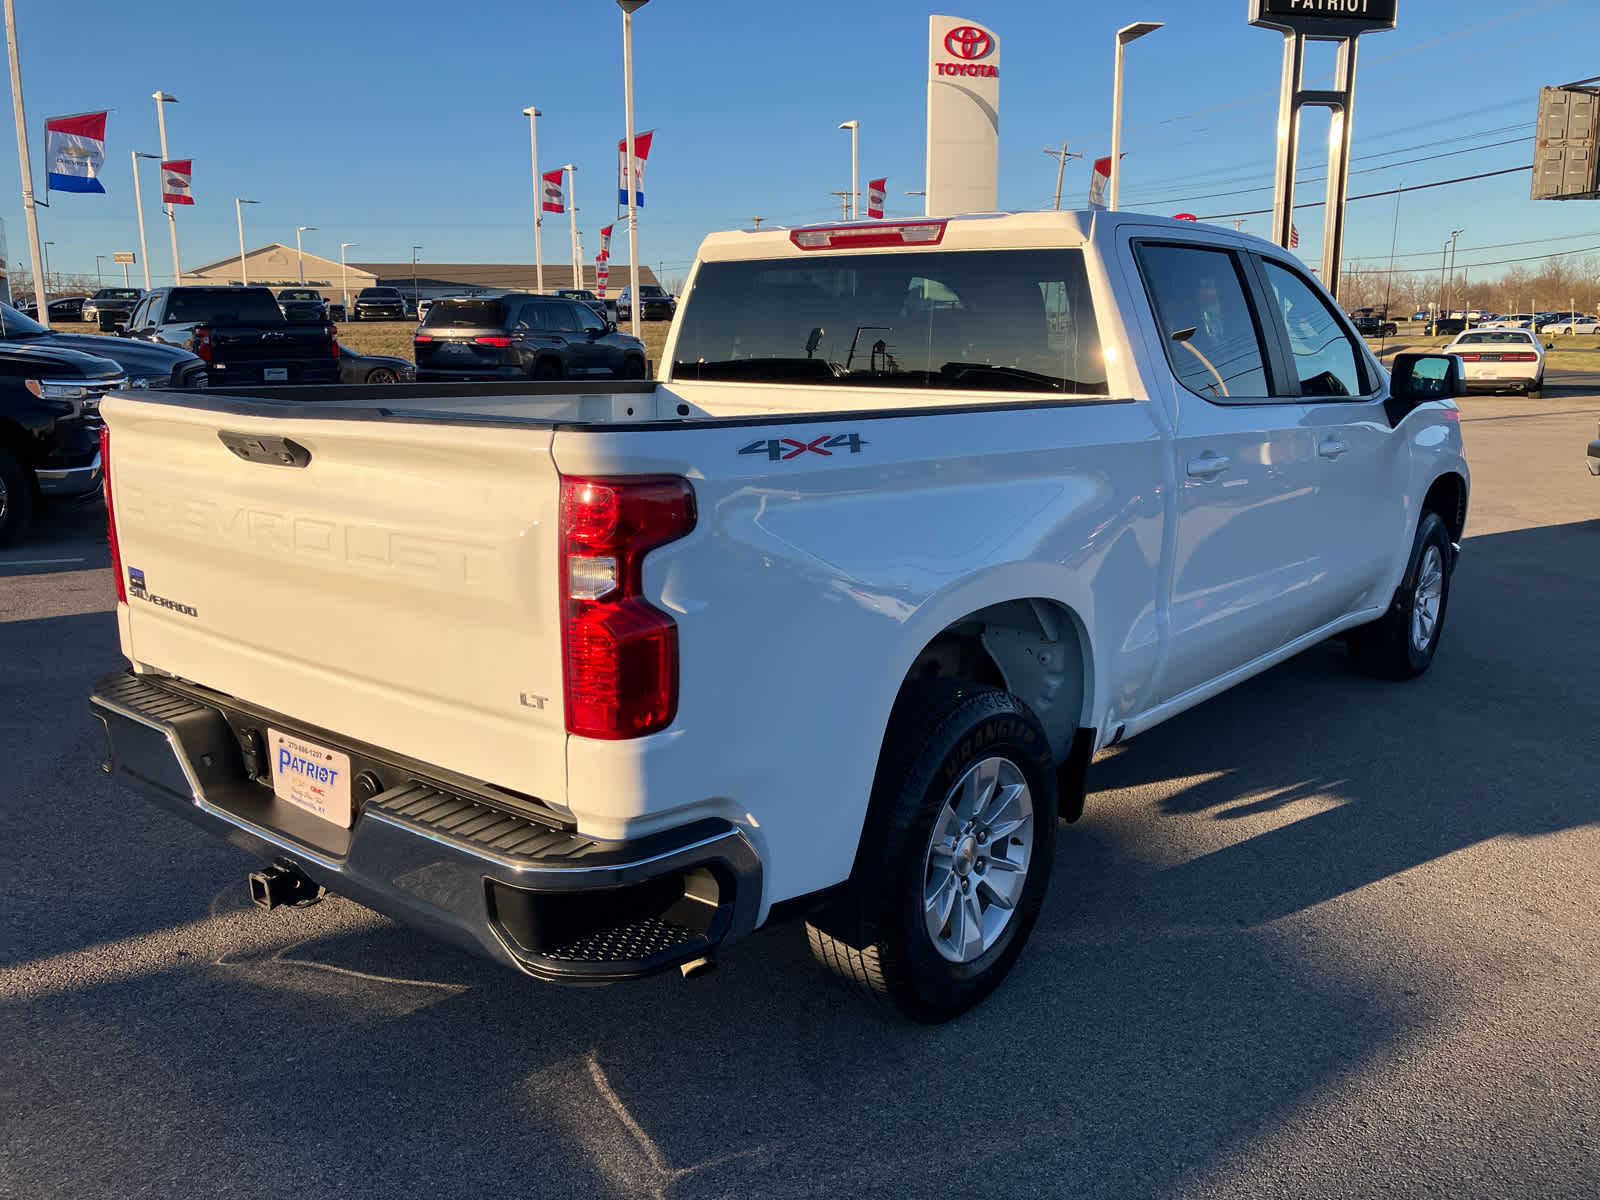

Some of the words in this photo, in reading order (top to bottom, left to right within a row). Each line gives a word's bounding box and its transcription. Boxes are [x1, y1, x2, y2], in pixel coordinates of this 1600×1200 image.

[935, 63, 999, 77] TOYOTA
[129, 587, 199, 618] SILVERADO
[520, 691, 549, 710] LT
[279, 748, 338, 786] PATRIOT
